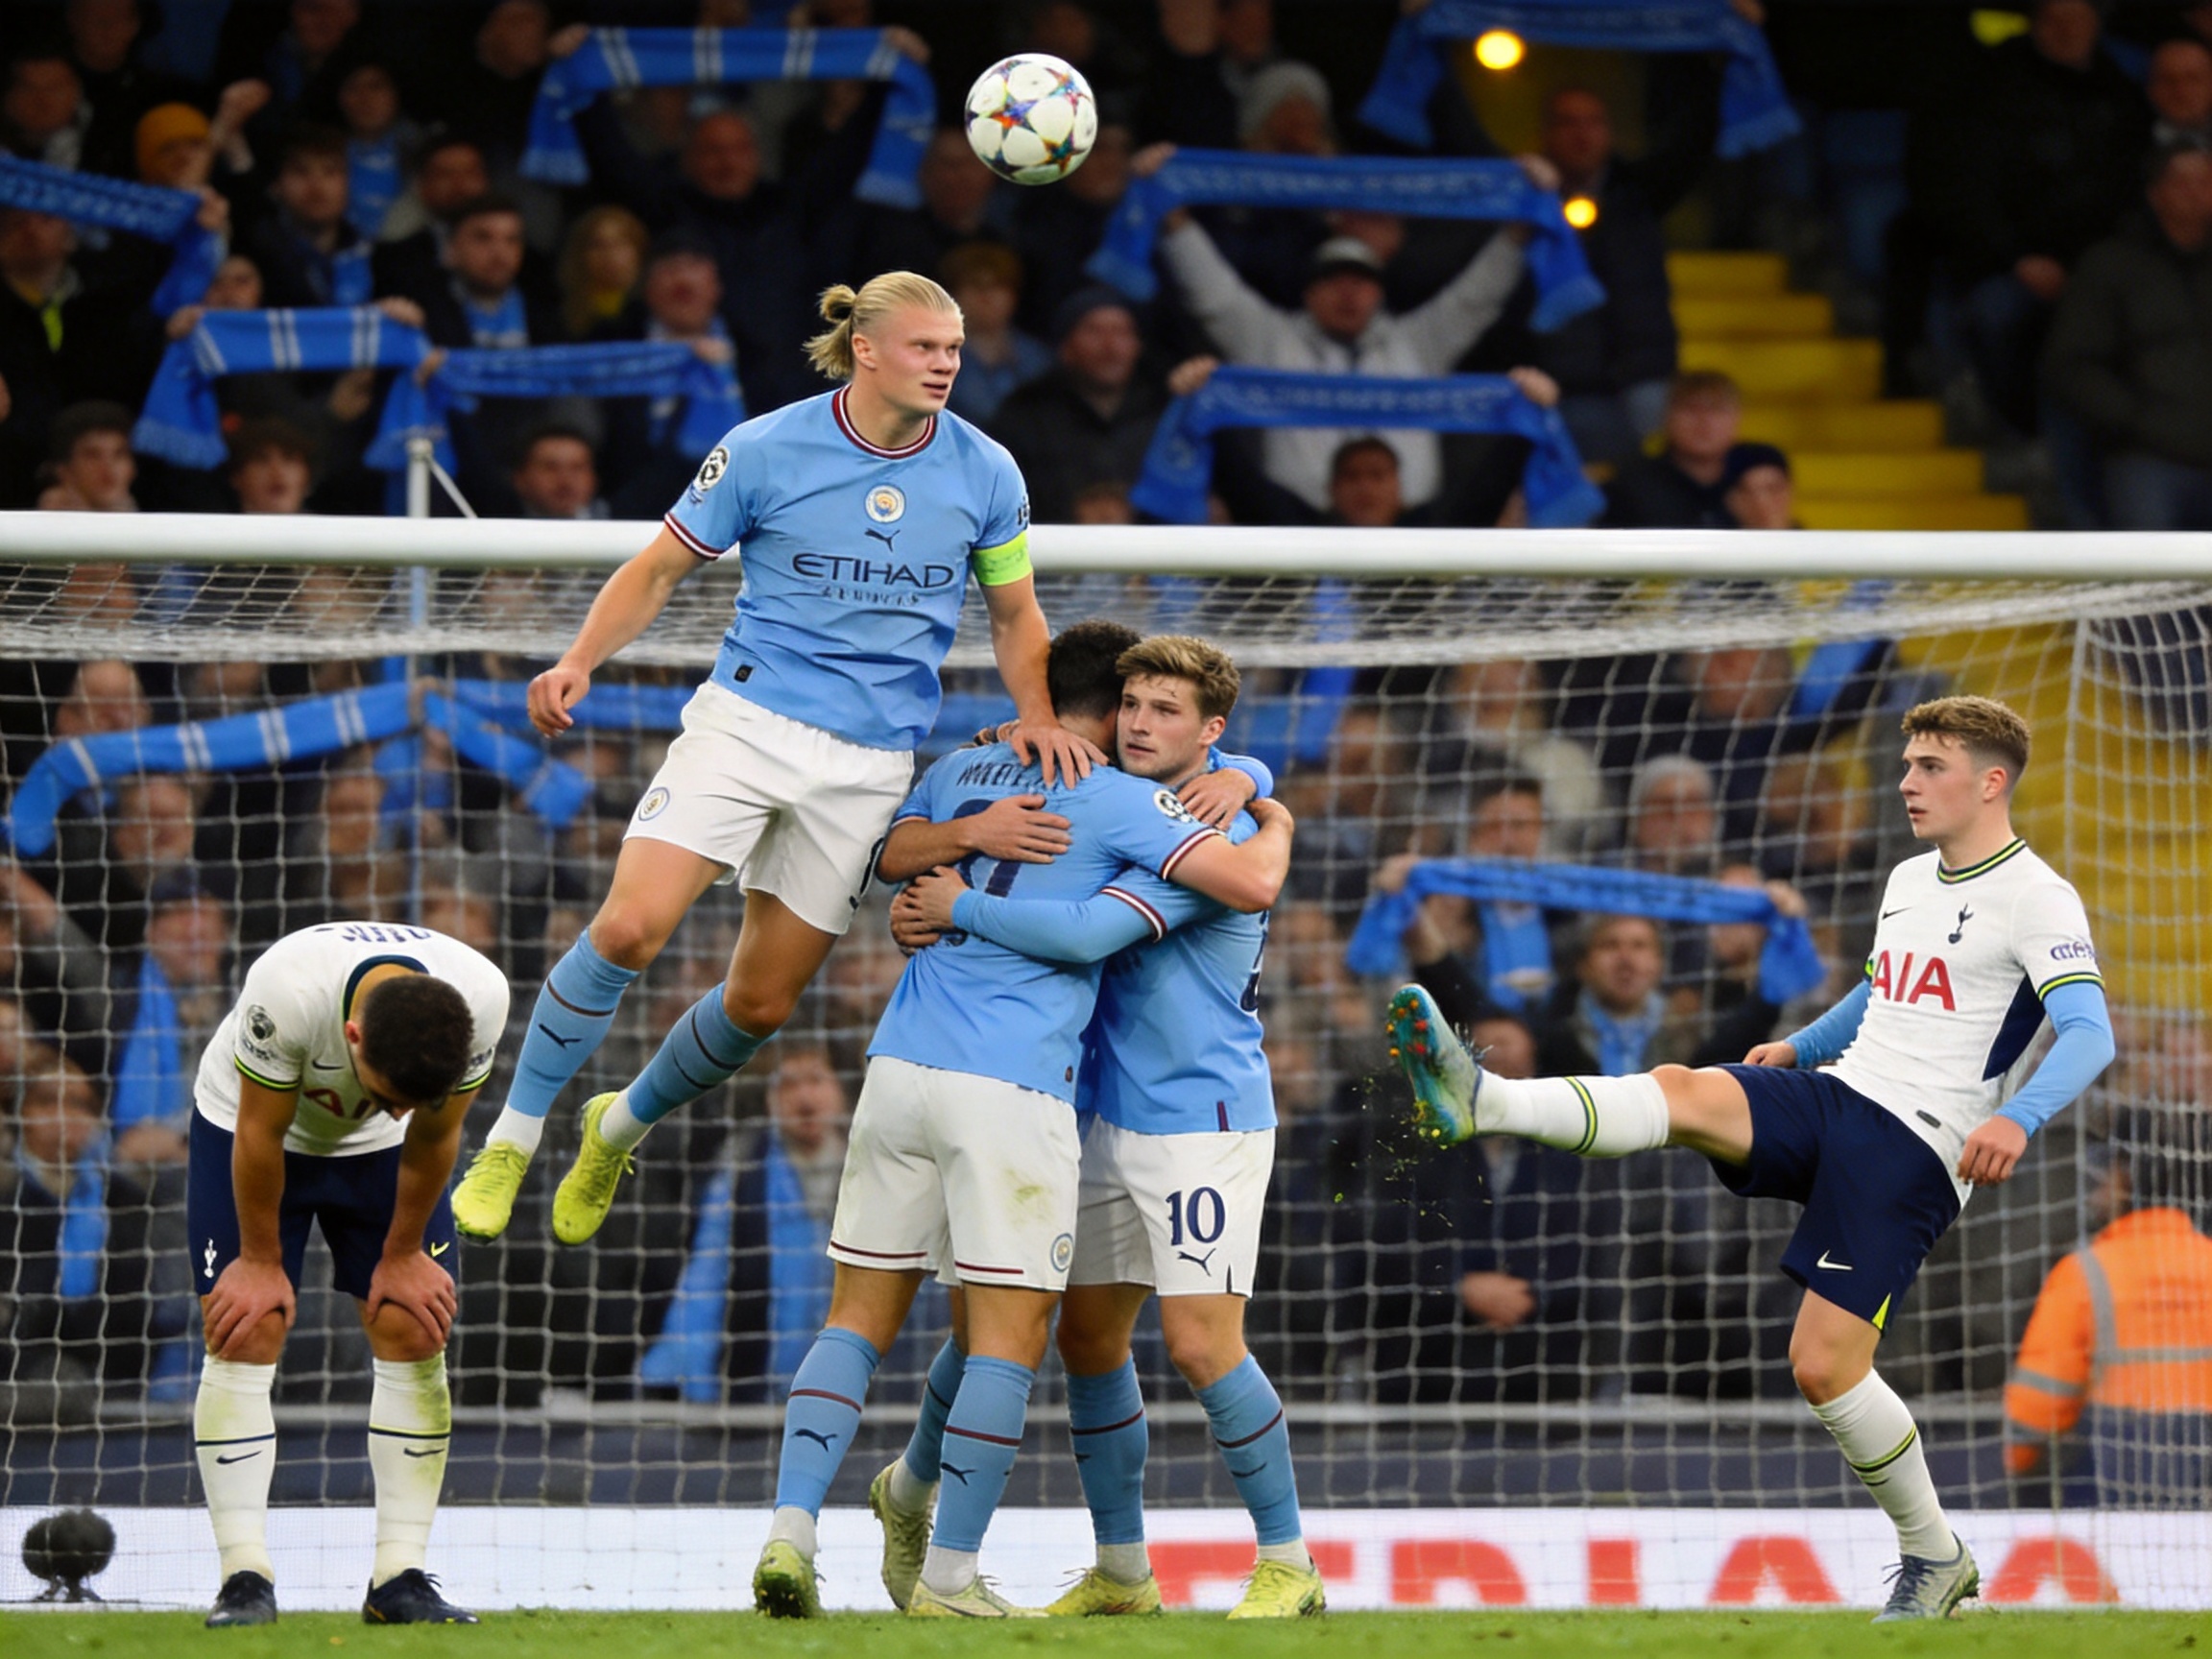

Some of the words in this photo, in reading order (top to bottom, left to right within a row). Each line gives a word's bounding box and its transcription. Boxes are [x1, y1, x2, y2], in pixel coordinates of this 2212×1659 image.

[792, 553, 954, 589] ETIHAD
[1873, 949, 1957, 1012] AIA
[303, 1088, 372, 1121] AI
[1166, 1186, 1226, 1246] 10
